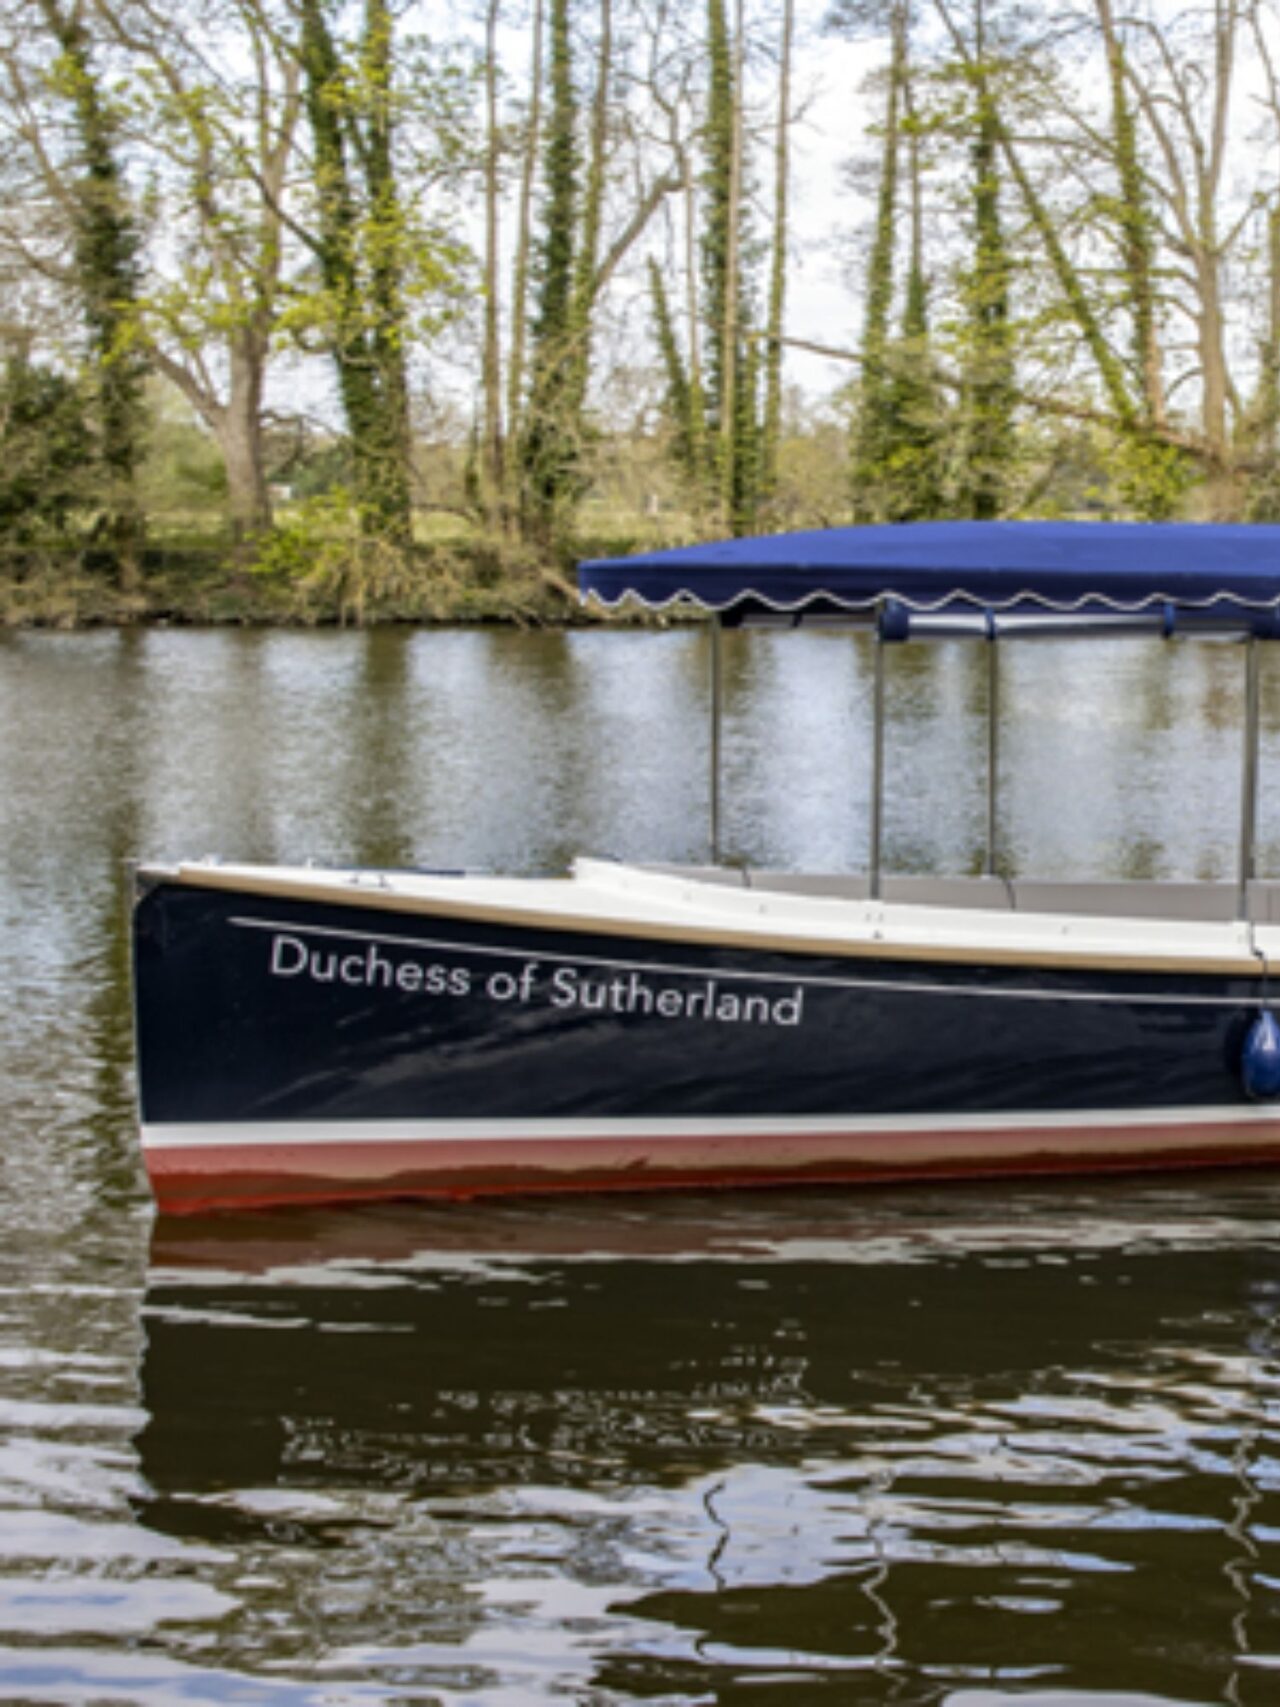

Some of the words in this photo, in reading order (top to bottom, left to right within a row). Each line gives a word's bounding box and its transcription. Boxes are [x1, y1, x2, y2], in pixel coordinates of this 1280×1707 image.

[270, 935, 471, 996] Duchess
[487, 961, 539, 1002] of
[550, 970, 804, 1027] Sutherland
